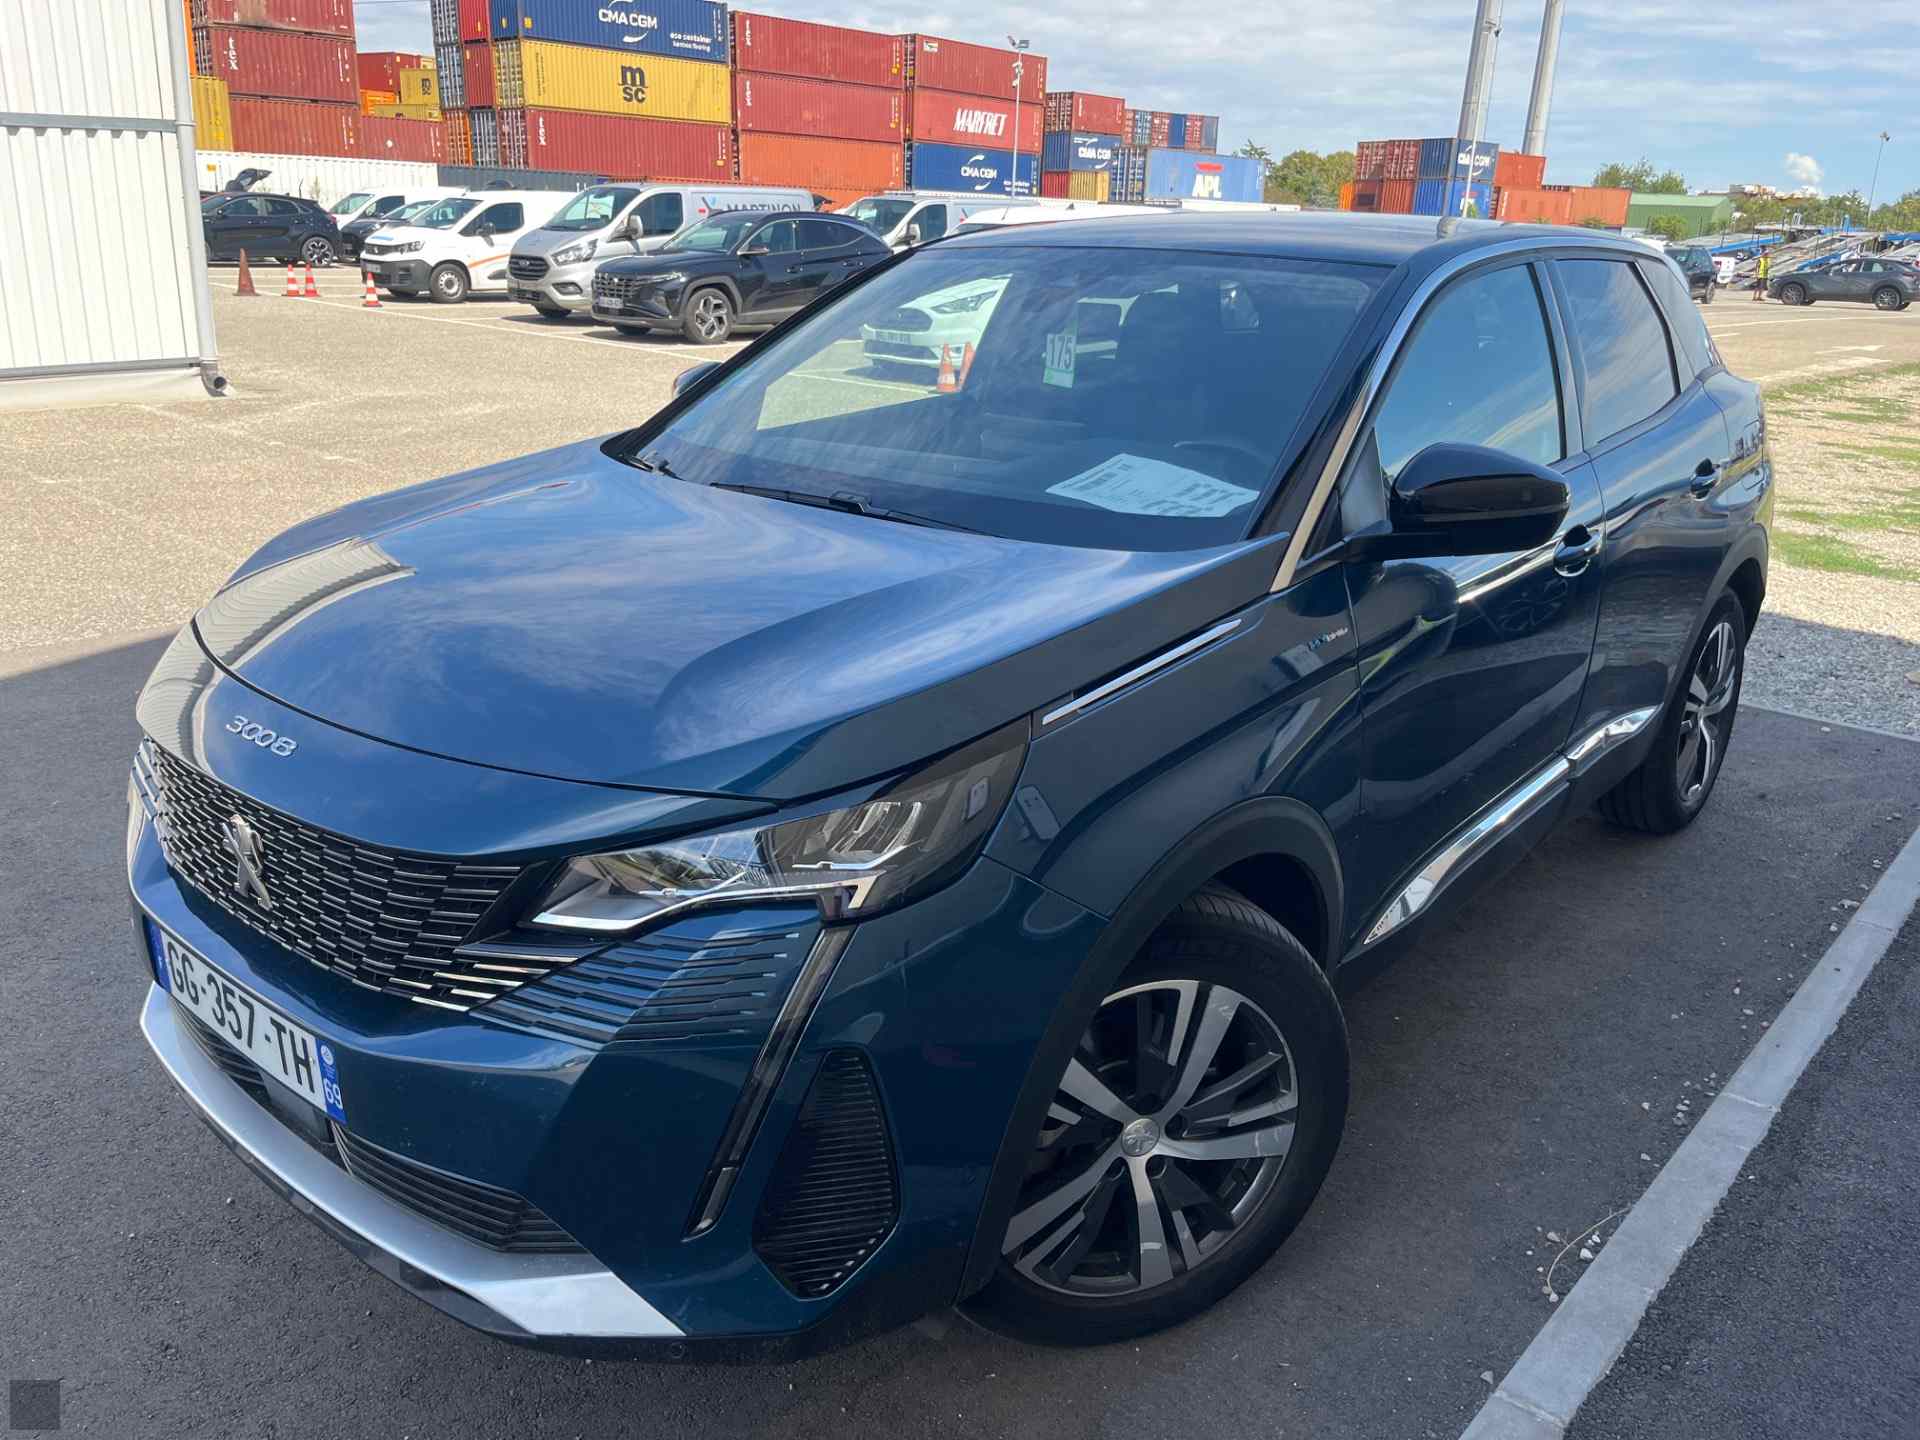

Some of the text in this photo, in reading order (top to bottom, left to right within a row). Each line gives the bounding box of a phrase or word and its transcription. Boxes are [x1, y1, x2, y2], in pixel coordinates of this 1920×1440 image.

[599, 9, 658, 29] CMA CGM
[228, 37, 239, 70] tex
[538, 116, 547, 145] tex
[961, 166, 980, 179] CMA
[1192, 173, 1222, 199] APL
[226, 715, 297, 757] 3008
[167, 941, 315, 1093] GG-357-TH
